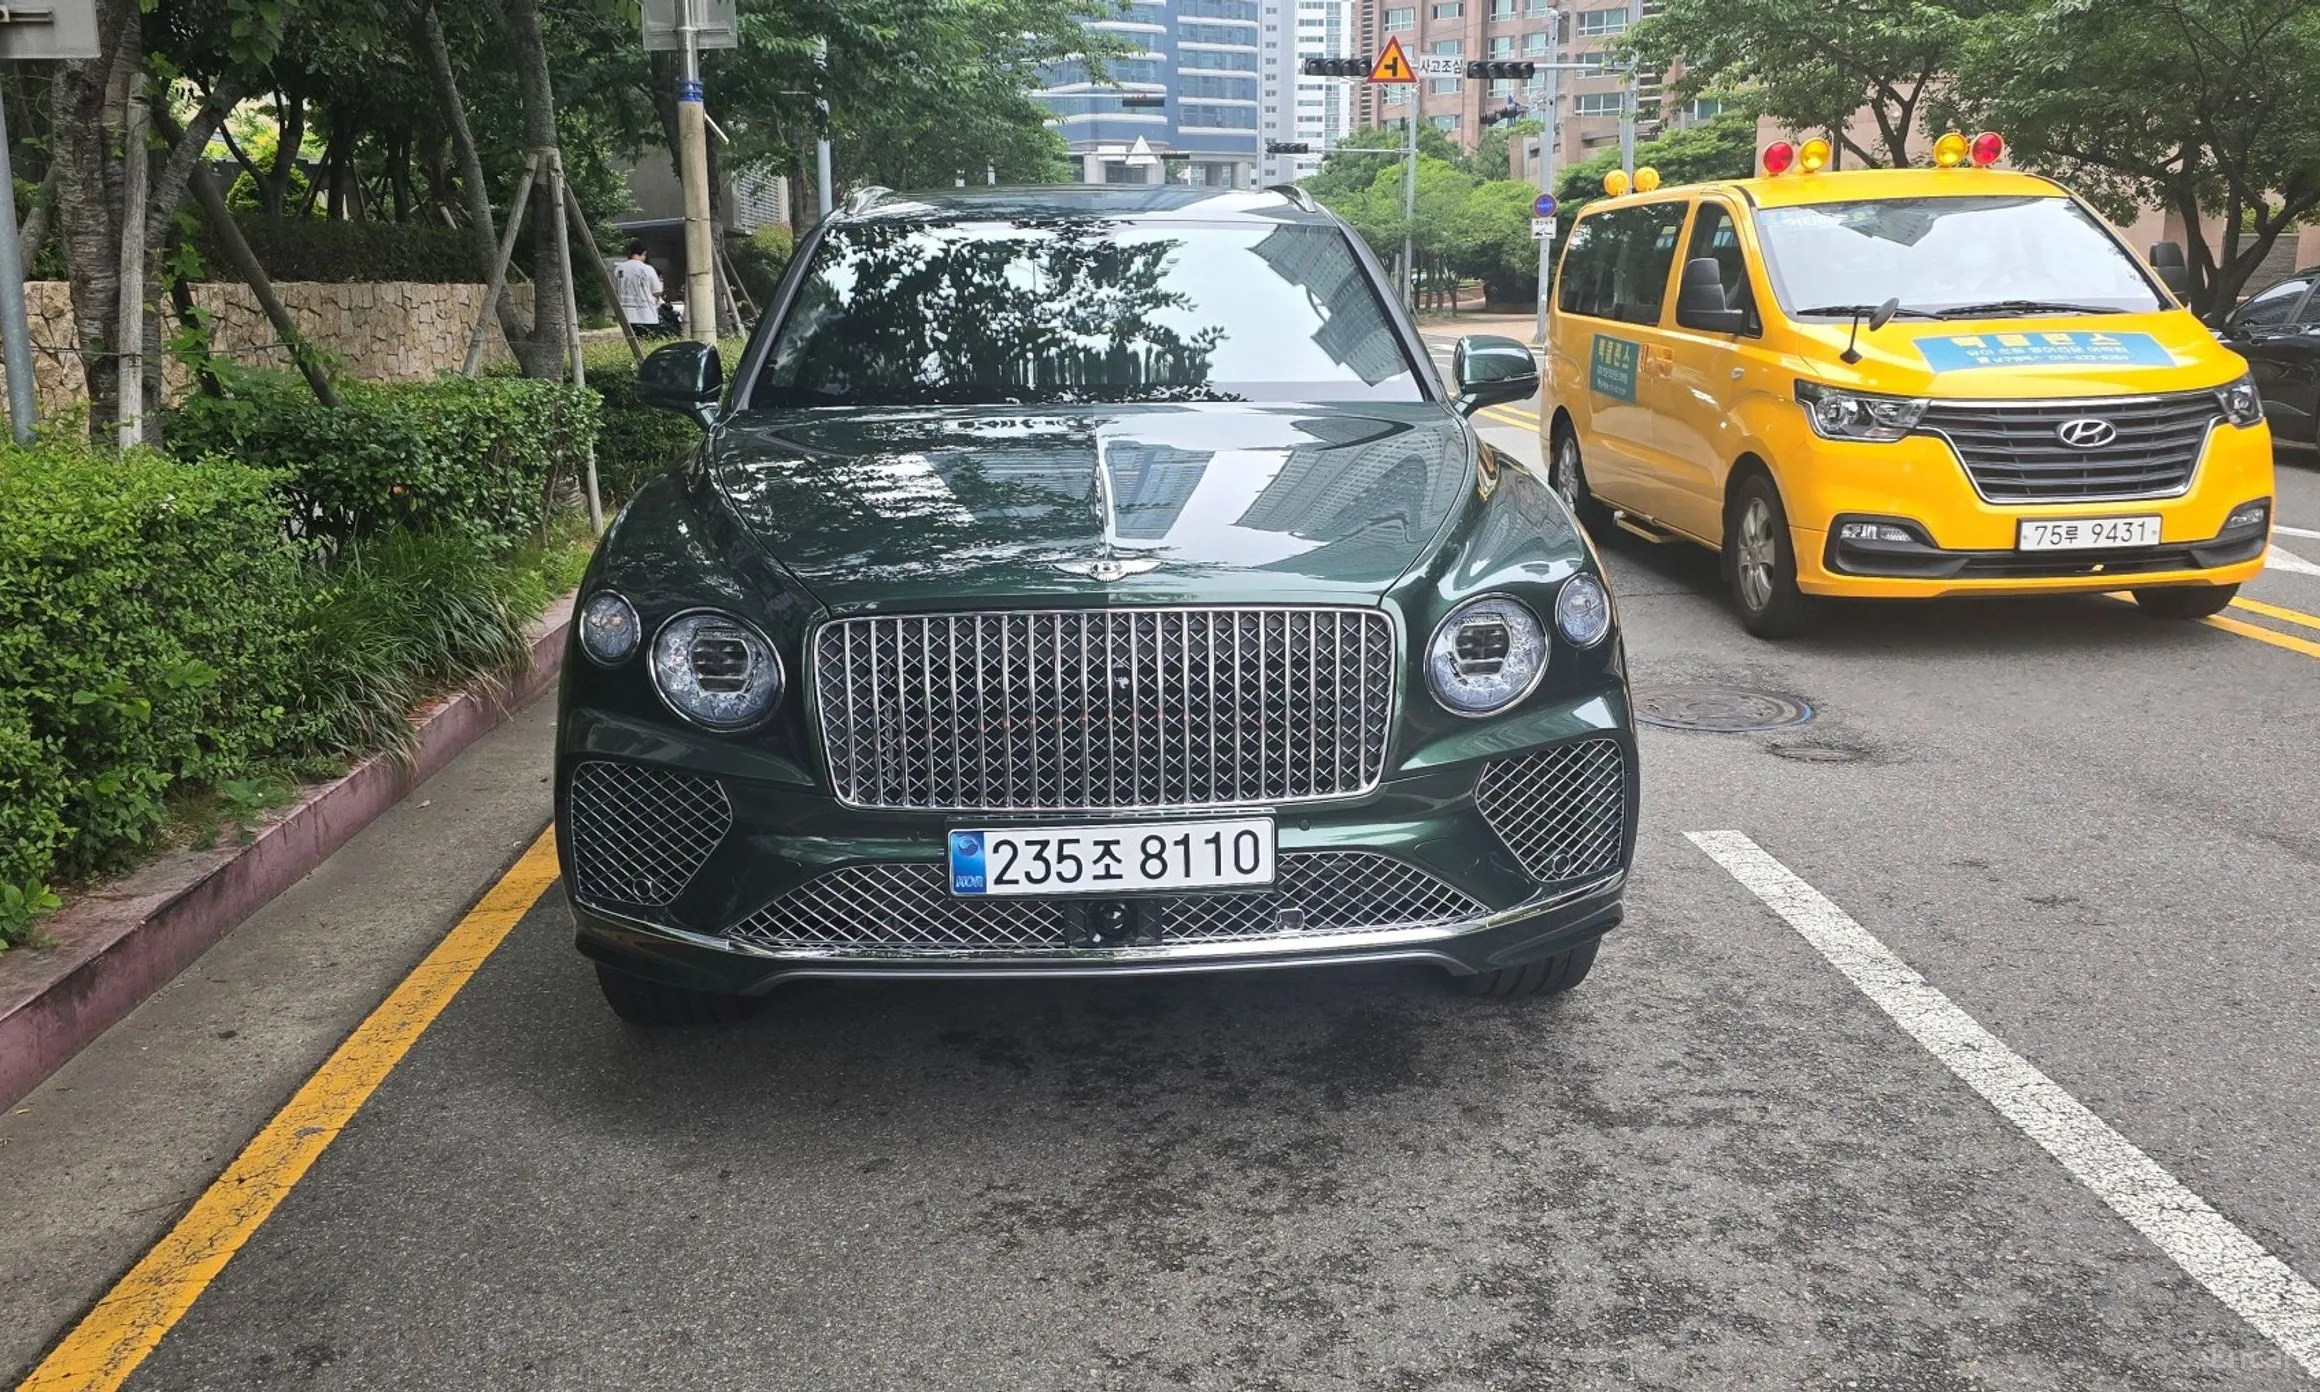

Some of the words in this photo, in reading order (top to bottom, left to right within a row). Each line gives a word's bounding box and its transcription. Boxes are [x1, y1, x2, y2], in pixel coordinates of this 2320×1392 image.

[1420, 58, 1462, 74] 사고조심
[2034, 524, 2079, 546] 75루
[2091, 520, 2146, 544] 9431
[992, 838, 1124, 886] 235조
[1139, 828, 1261, 880] 8110
